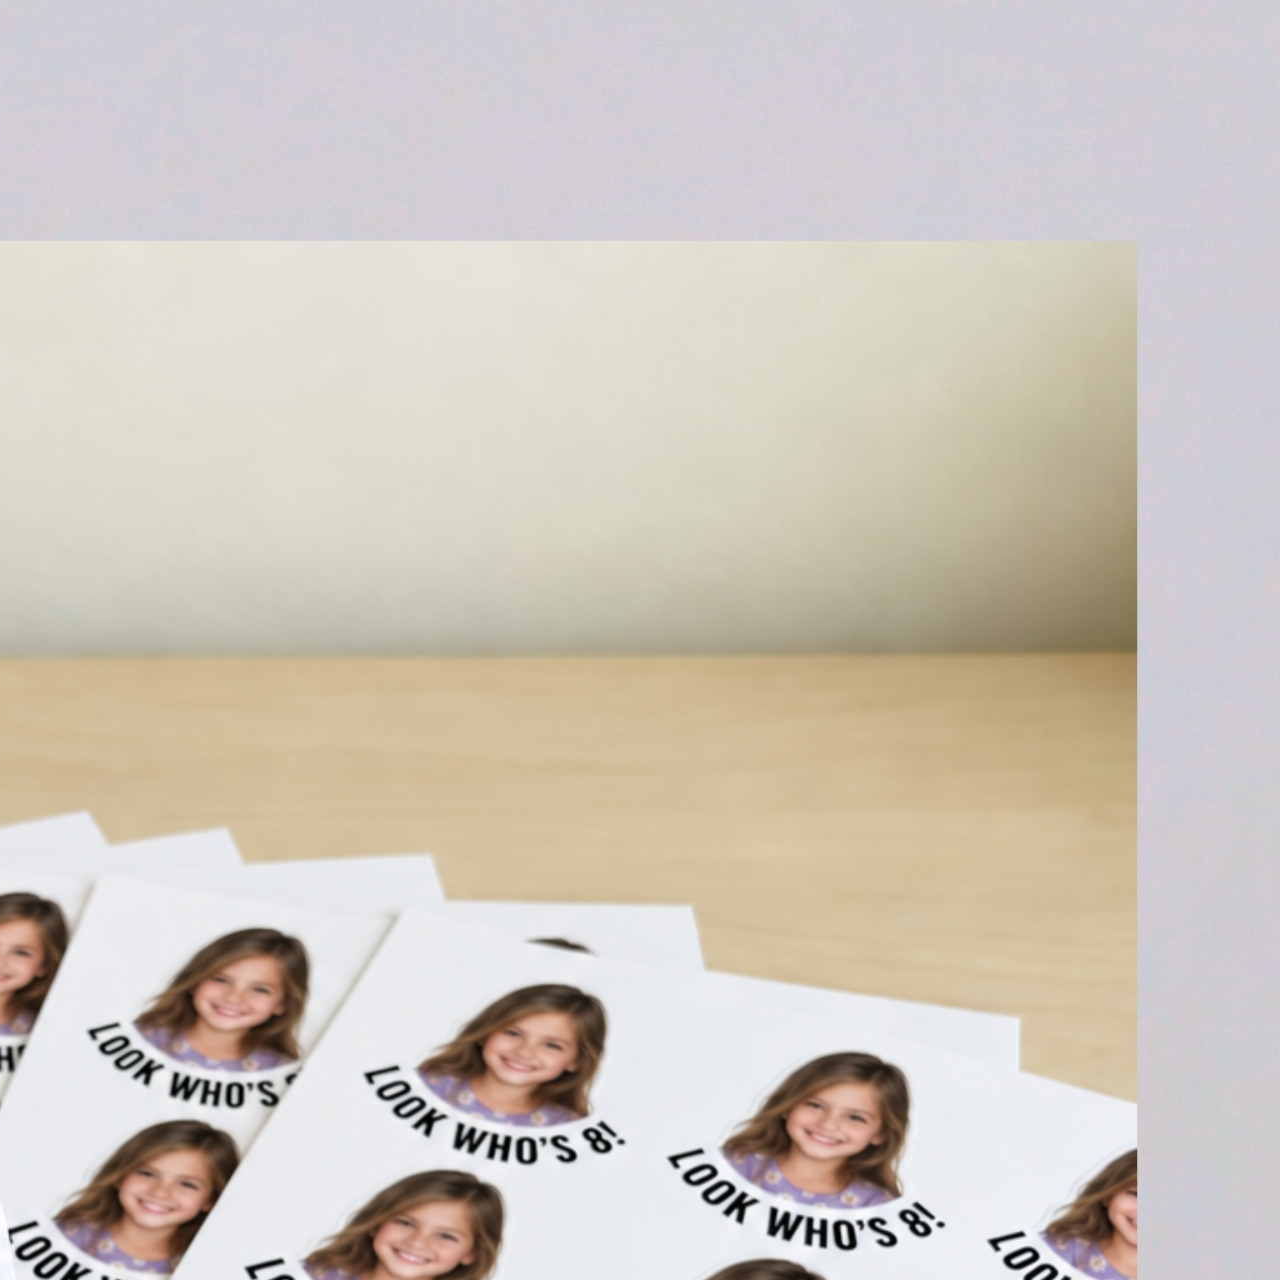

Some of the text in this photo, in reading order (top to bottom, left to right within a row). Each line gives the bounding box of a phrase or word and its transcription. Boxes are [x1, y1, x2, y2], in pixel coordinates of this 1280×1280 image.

[89, 1023, 163, 1085] LOOK
[170, 1073, 279, 1108] WHO’S
[365, 1066, 624, 1164] LOOK WHO’S 8!
[669, 1149, 945, 1250] LOOK WHO’S 8!
